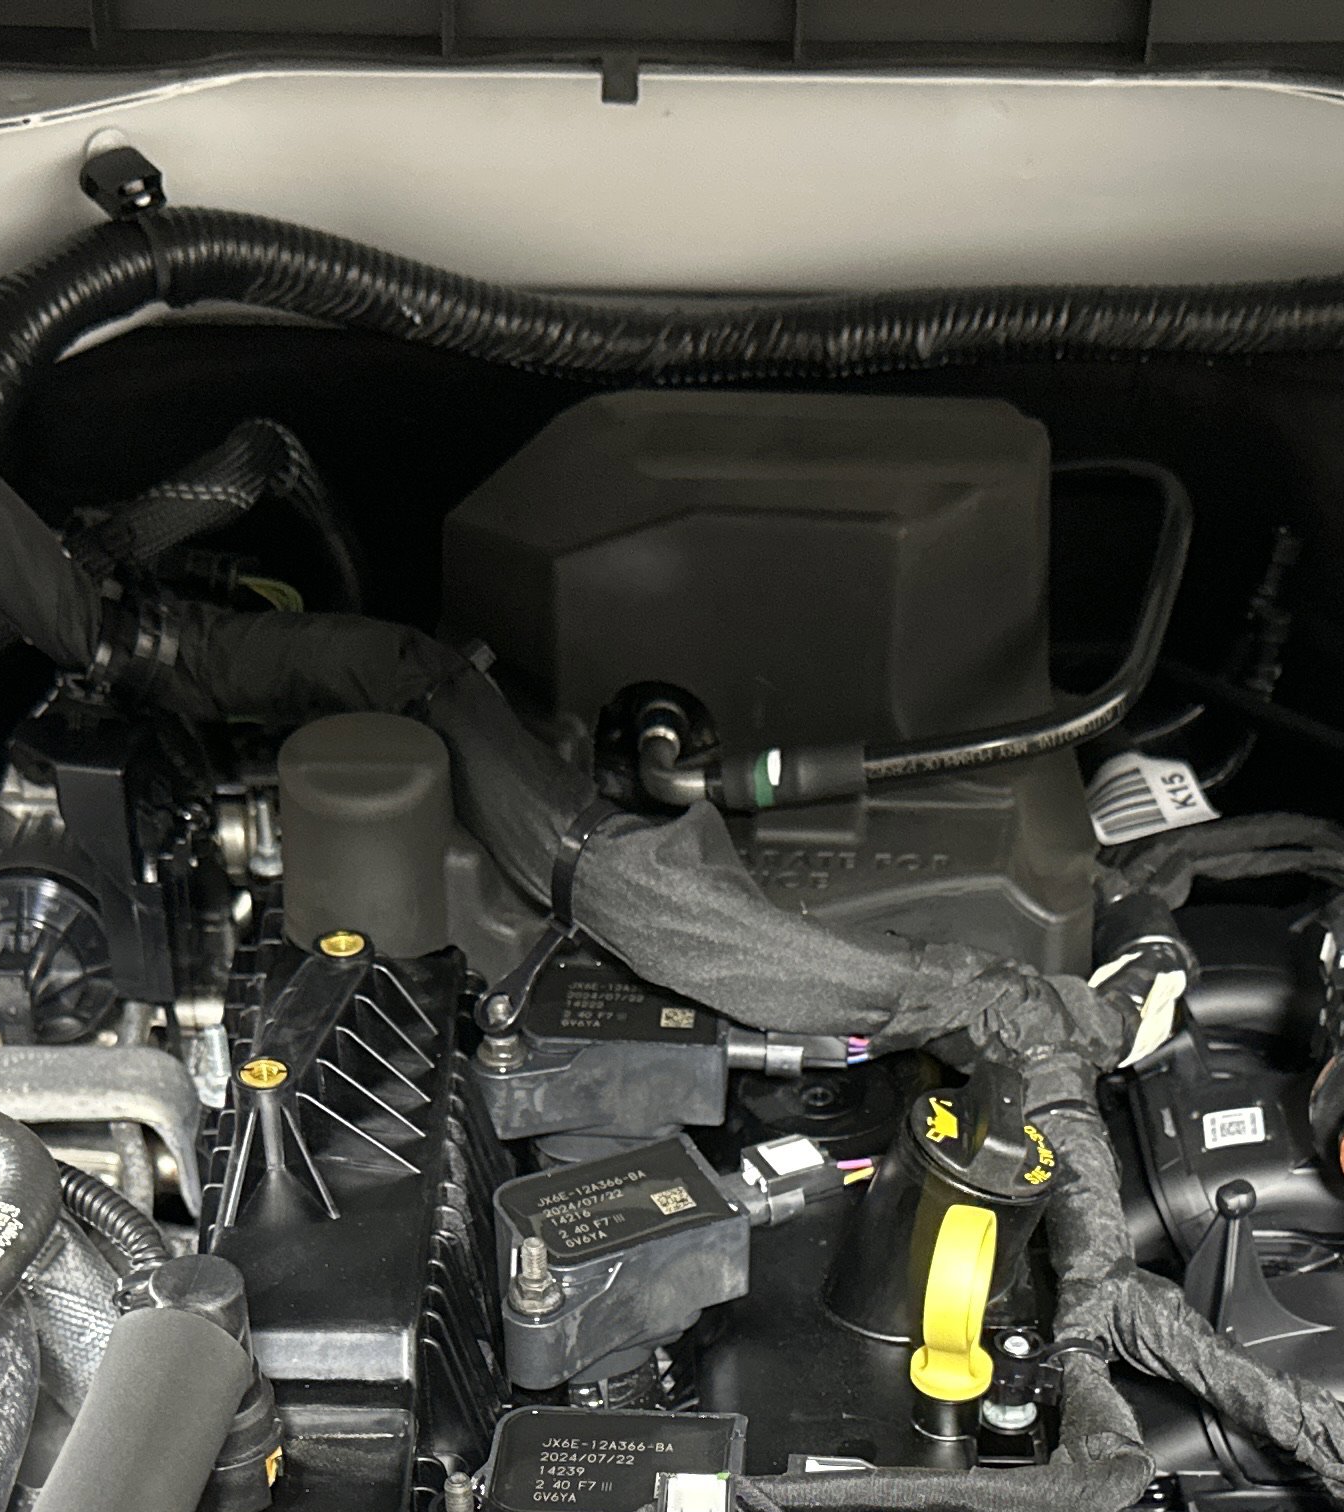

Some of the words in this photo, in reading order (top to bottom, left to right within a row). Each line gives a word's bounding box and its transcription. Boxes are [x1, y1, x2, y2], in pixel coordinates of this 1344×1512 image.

[1159, 770, 1197, 810] K15
[537, 1169, 647, 1208] JX6E-12A366-BA
[543, 1188, 625, 1218] 2024/07/22
[551, 1210, 592, 1228] 14216
[558, 1229, 570, 1240] 2
[574, 1223, 590, 1235] 40
[541, 1437, 674, 1453] JX6E-12A366-BA
[539, 1451, 636, 1466] 2024/07/22
[539, 1465, 586, 1477] 14239
[535, 1479, 545, 1490] 2
[552, 1480, 572, 1490] 40
[577, 1480, 598, 1491] F7
